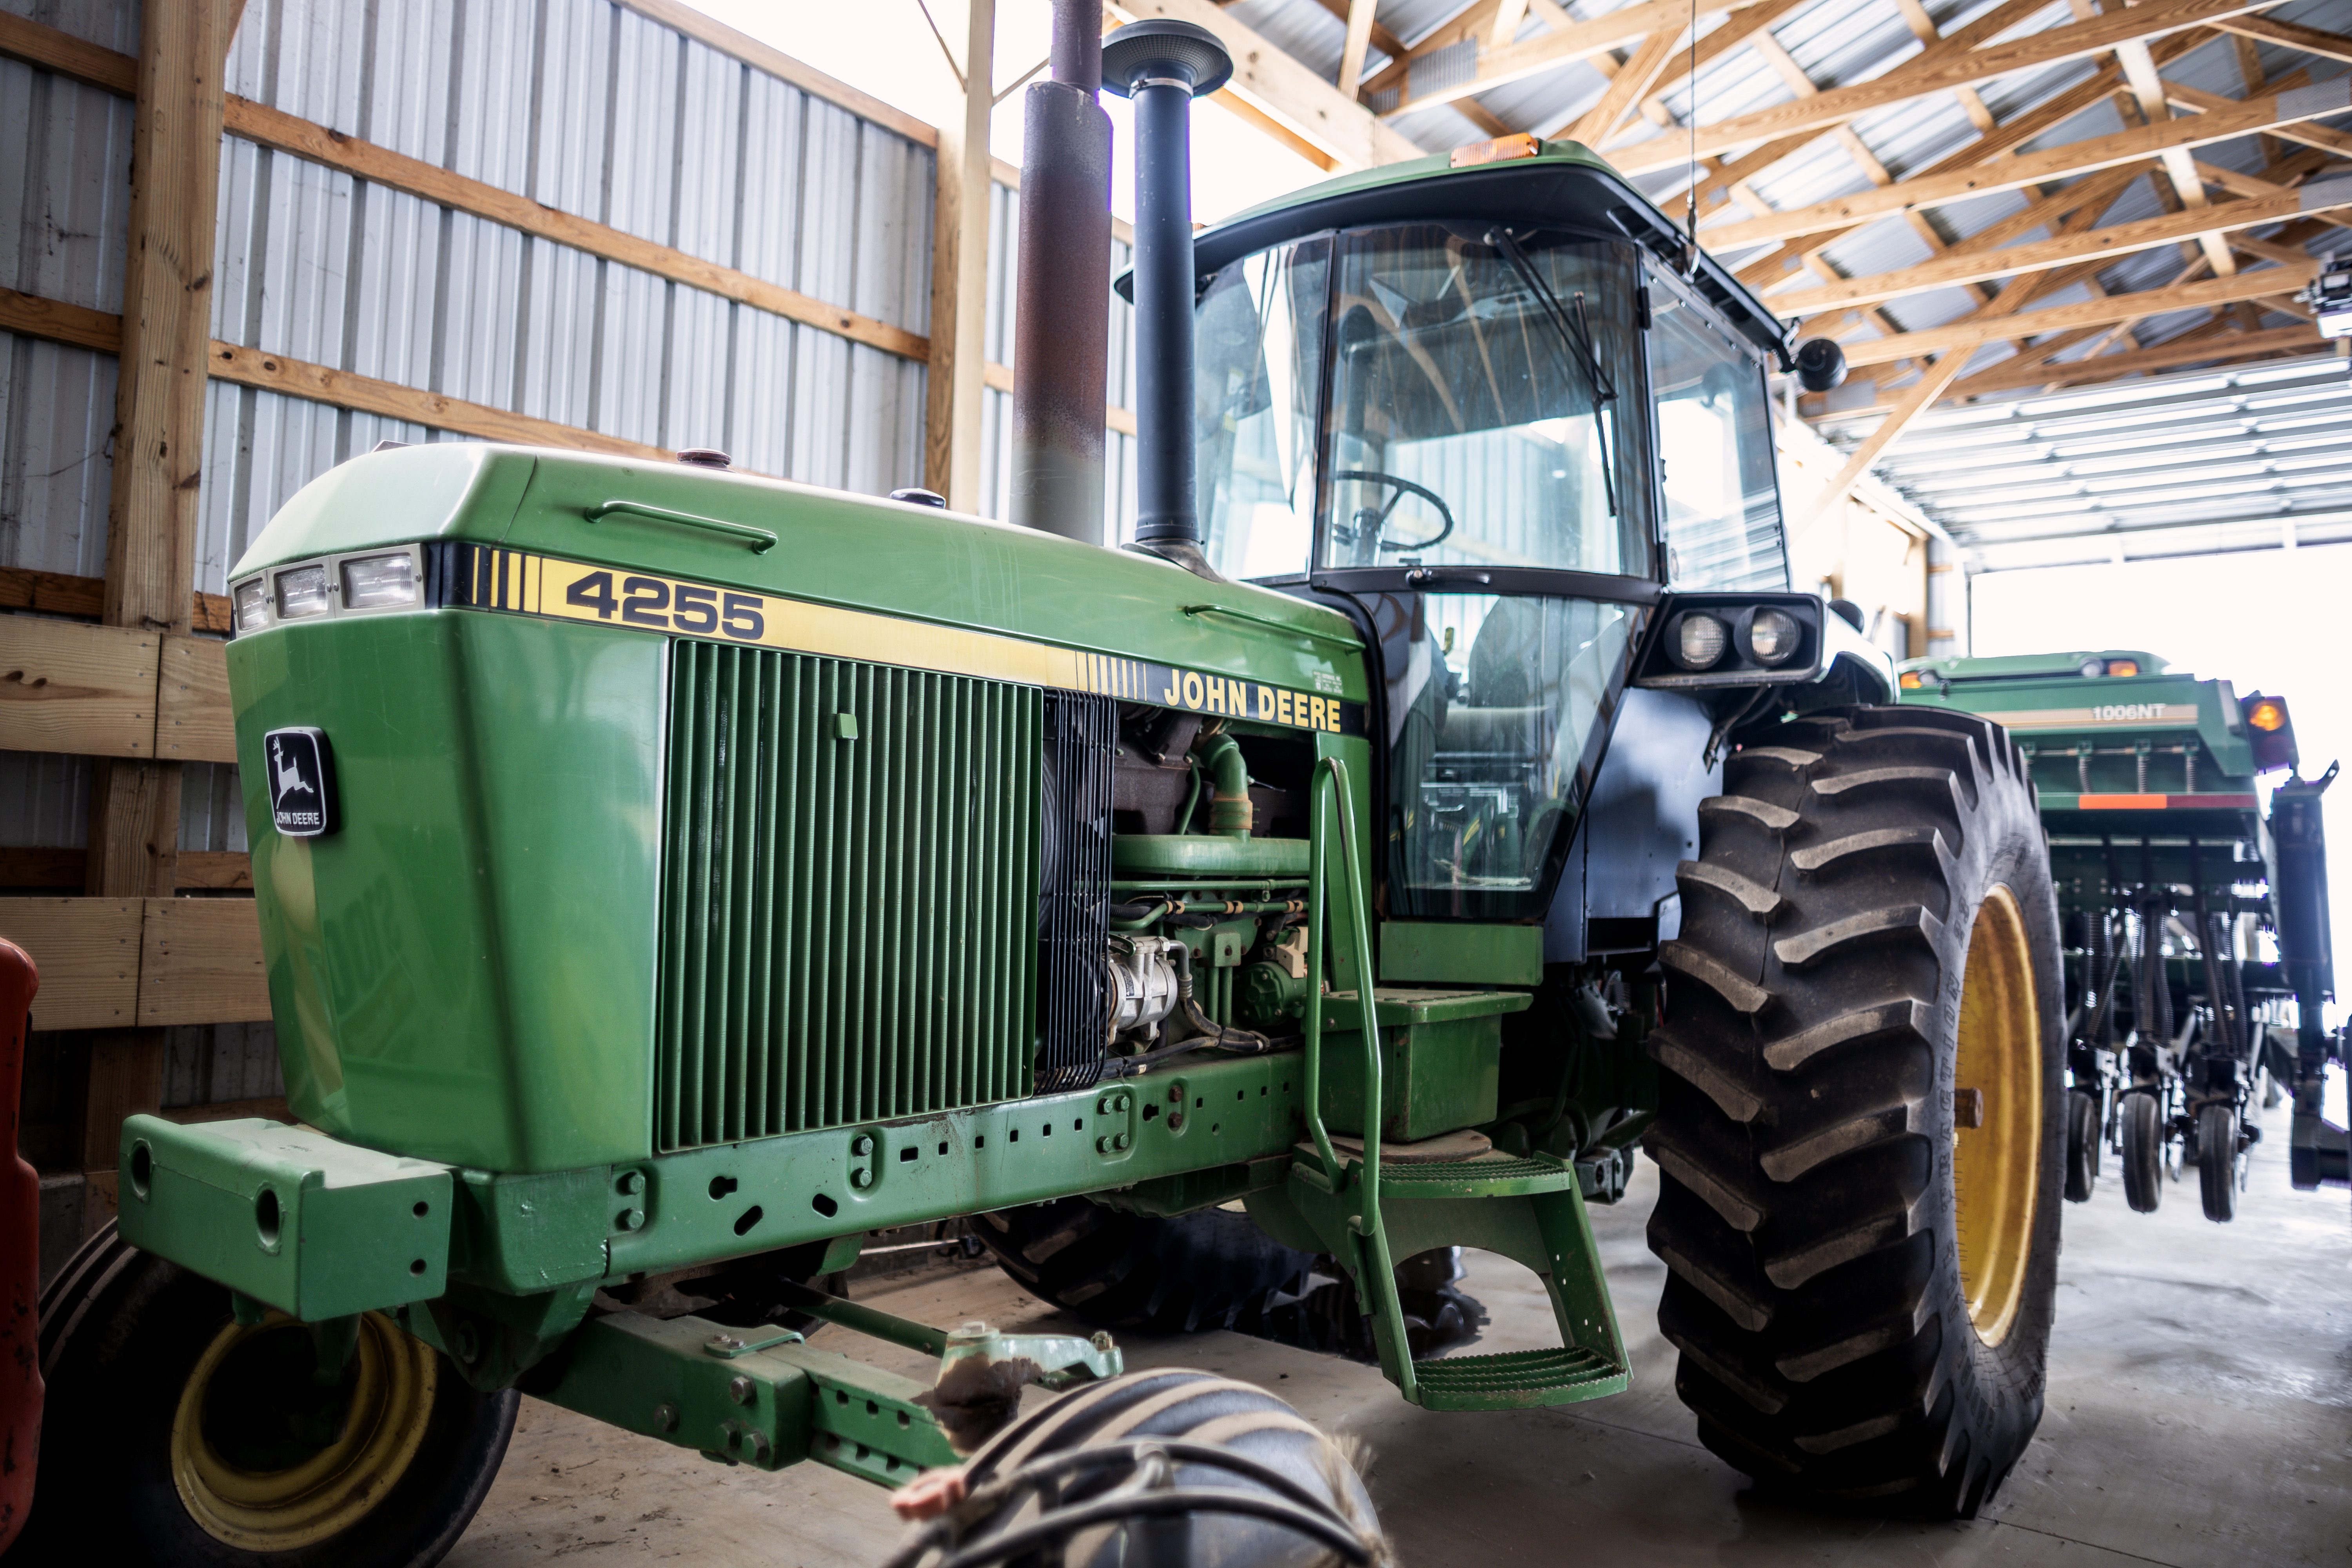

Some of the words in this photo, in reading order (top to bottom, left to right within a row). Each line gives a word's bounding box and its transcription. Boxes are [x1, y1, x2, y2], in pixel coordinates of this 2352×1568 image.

[566, 571, 764, 641] 4255
[1164, 669, 1247, 717] JOHN
[1258, 685, 1341, 733] DEERE
[2092, 703, 2166, 721] 1006NT
[276, 811, 292, 824] JOHN
[292, 812, 320, 825] DEERE
